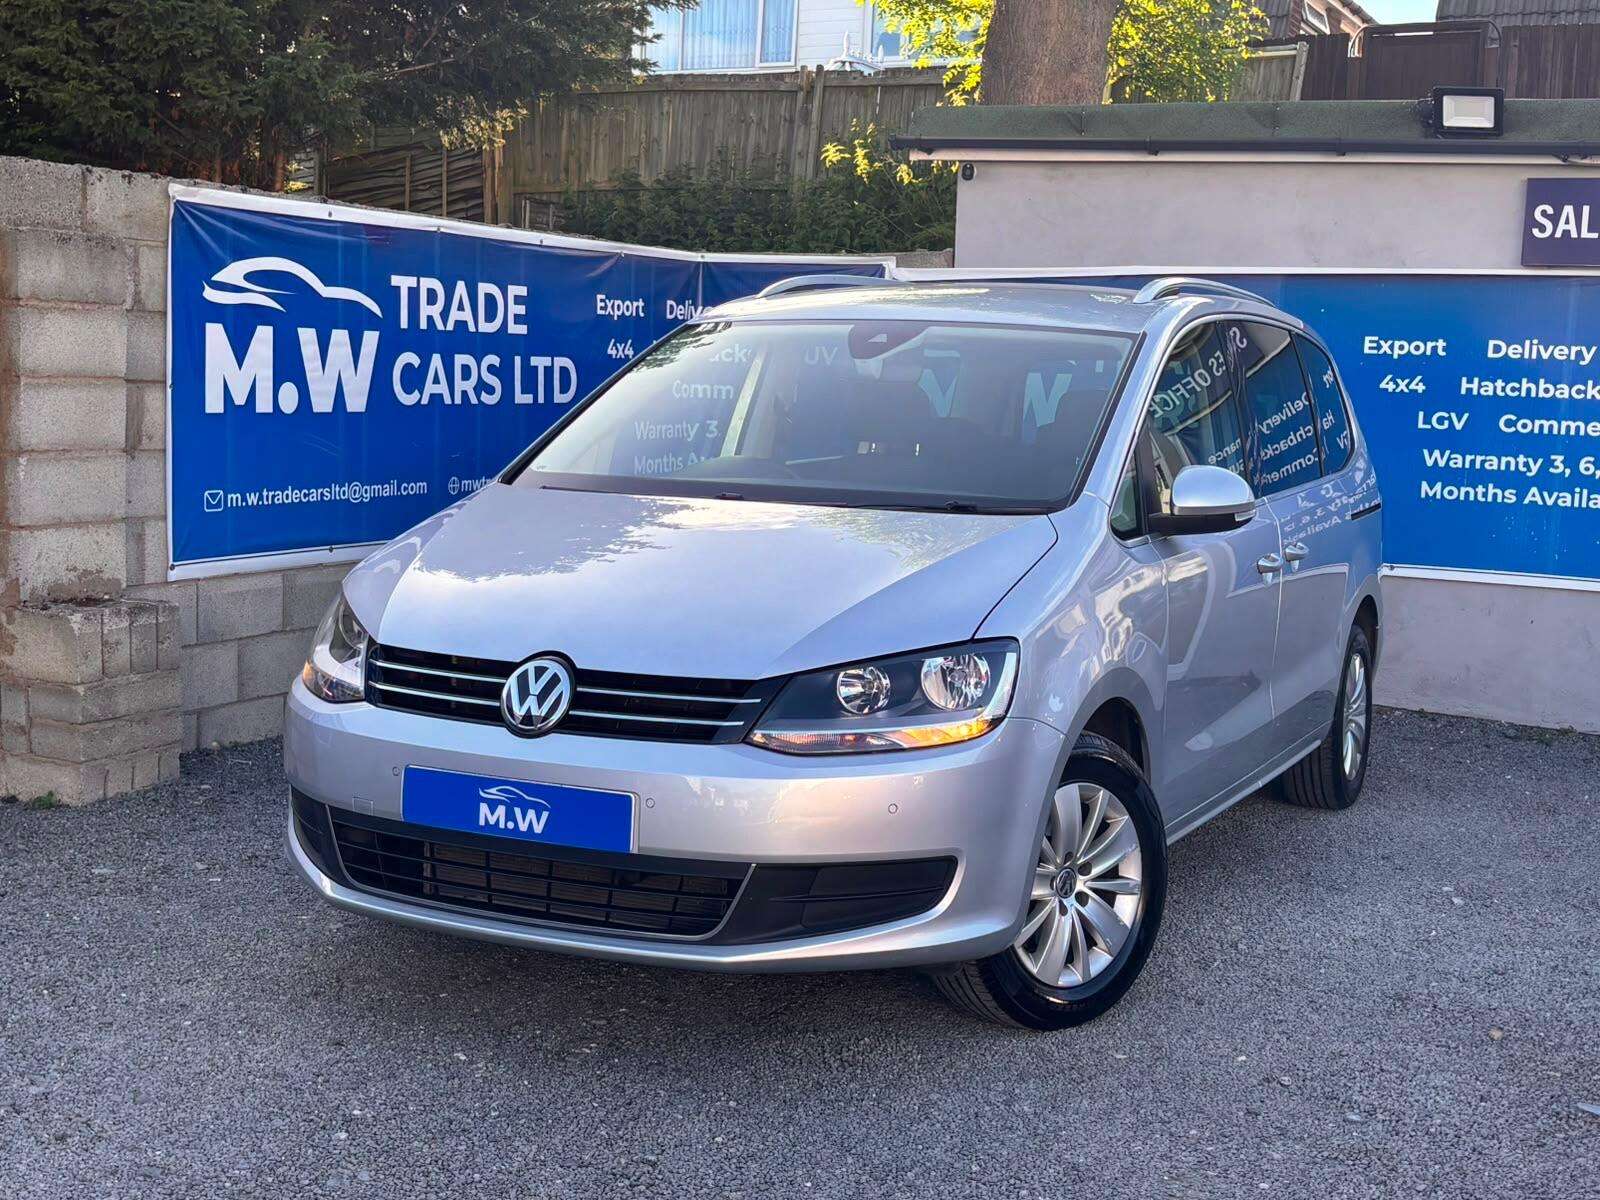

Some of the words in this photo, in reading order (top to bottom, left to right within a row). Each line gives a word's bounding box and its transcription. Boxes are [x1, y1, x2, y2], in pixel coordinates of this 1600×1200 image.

[1531, 203, 1600, 239] SAL
[390, 274, 528, 335] TRADE
[595, 293, 645, 320] Export
[606, 338, 635, 359] 4x4
[1362, 335, 1448, 360] Export
[1486, 338, 1599, 366] Delivery
[204, 321, 381, 415] M.W
[391, 351, 503, 406] CARS
[513, 354, 579, 405] LTD
[1378, 374, 1427, 394] 4x4
[1459, 376, 1600, 400] Hatchback
[633, 420, 700, 442] Warranty
[1416, 410, 1470, 431] LGV
[1498, 414, 1600, 437] Comme
[1422, 448, 1544, 476] Warranty
[1548, 454, 1571, 478] 3,
[227, 478, 428, 508] m.w.tradecarsltd@gmail.com
[1420, 480, 1517, 504] Months
[1522, 486, 1600, 509] Availa
[478, 801, 550, 835] M.W
